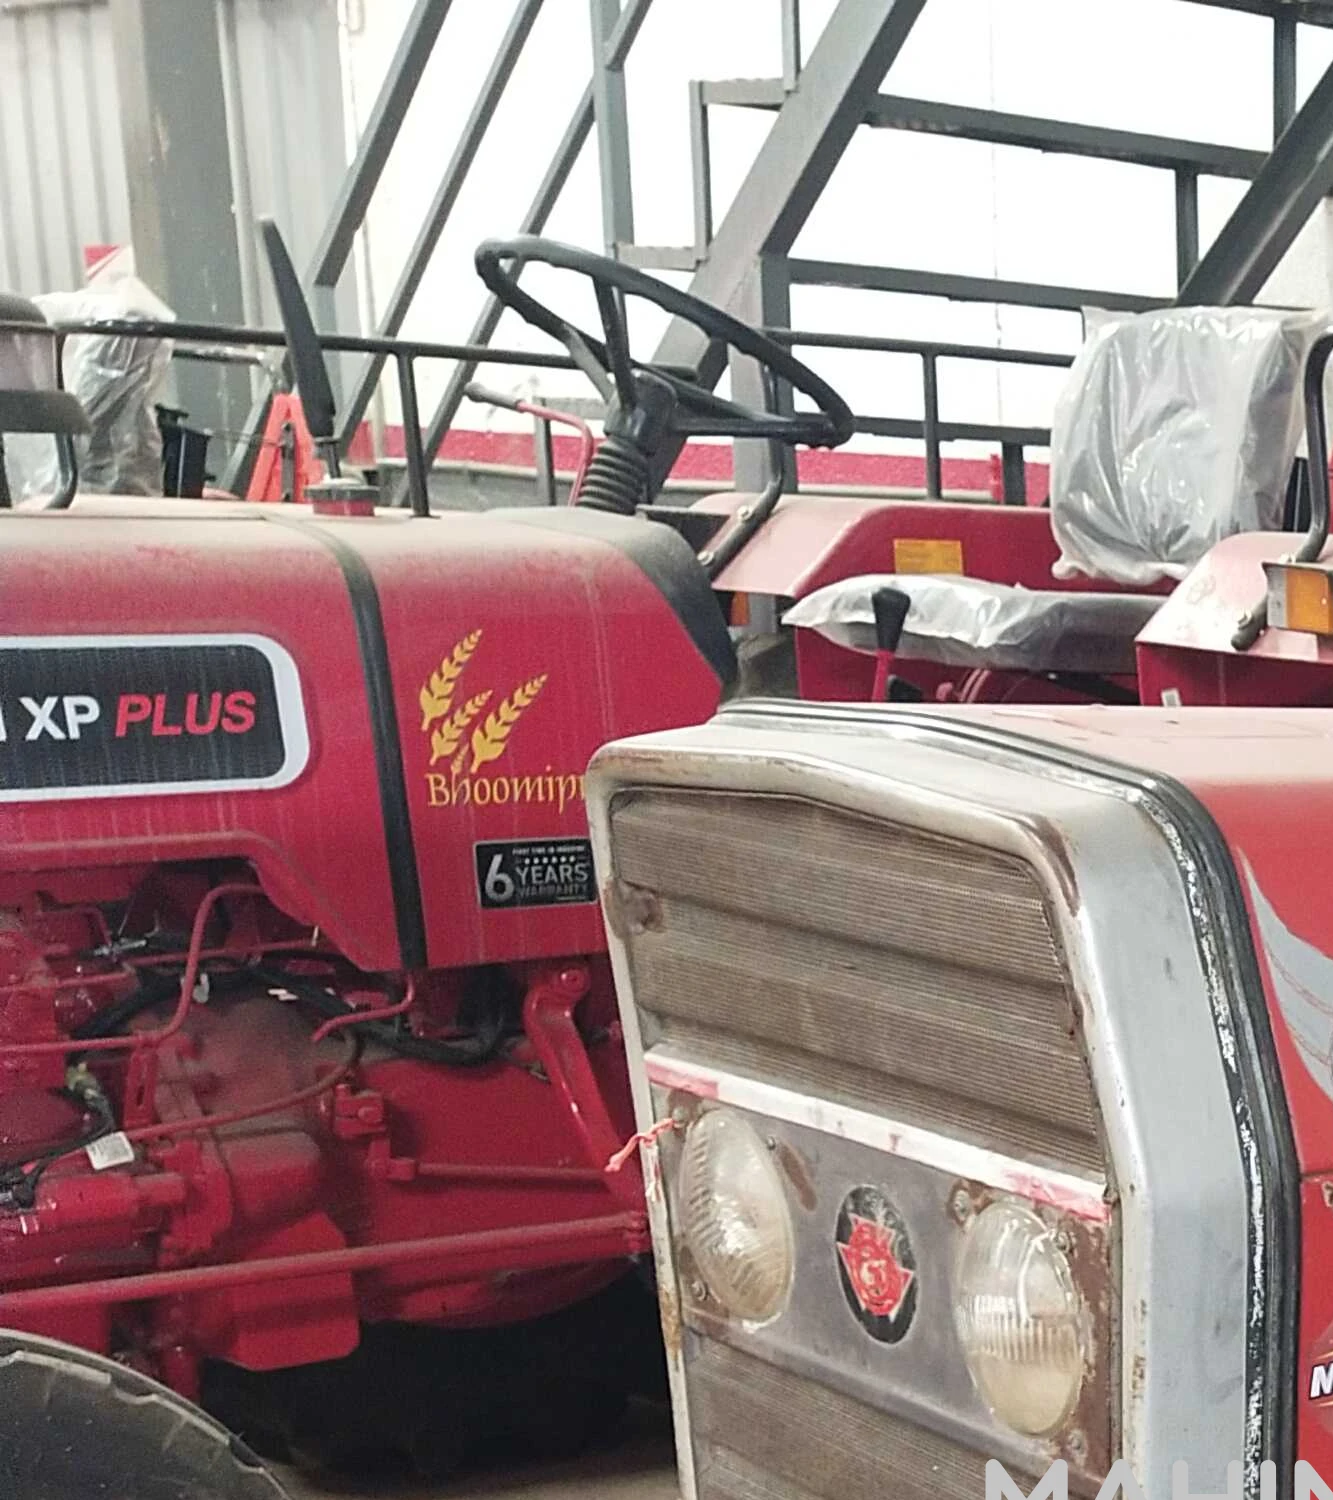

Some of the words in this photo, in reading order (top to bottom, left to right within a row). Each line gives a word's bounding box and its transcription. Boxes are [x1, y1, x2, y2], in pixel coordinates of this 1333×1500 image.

[18, 695, 100, 741] XP
[115, 690, 256, 737] PLUS
[424, 765, 587, 815] Bhoomip
[484, 853, 514, 900] 6
[515, 863, 589, 886] YEARS
